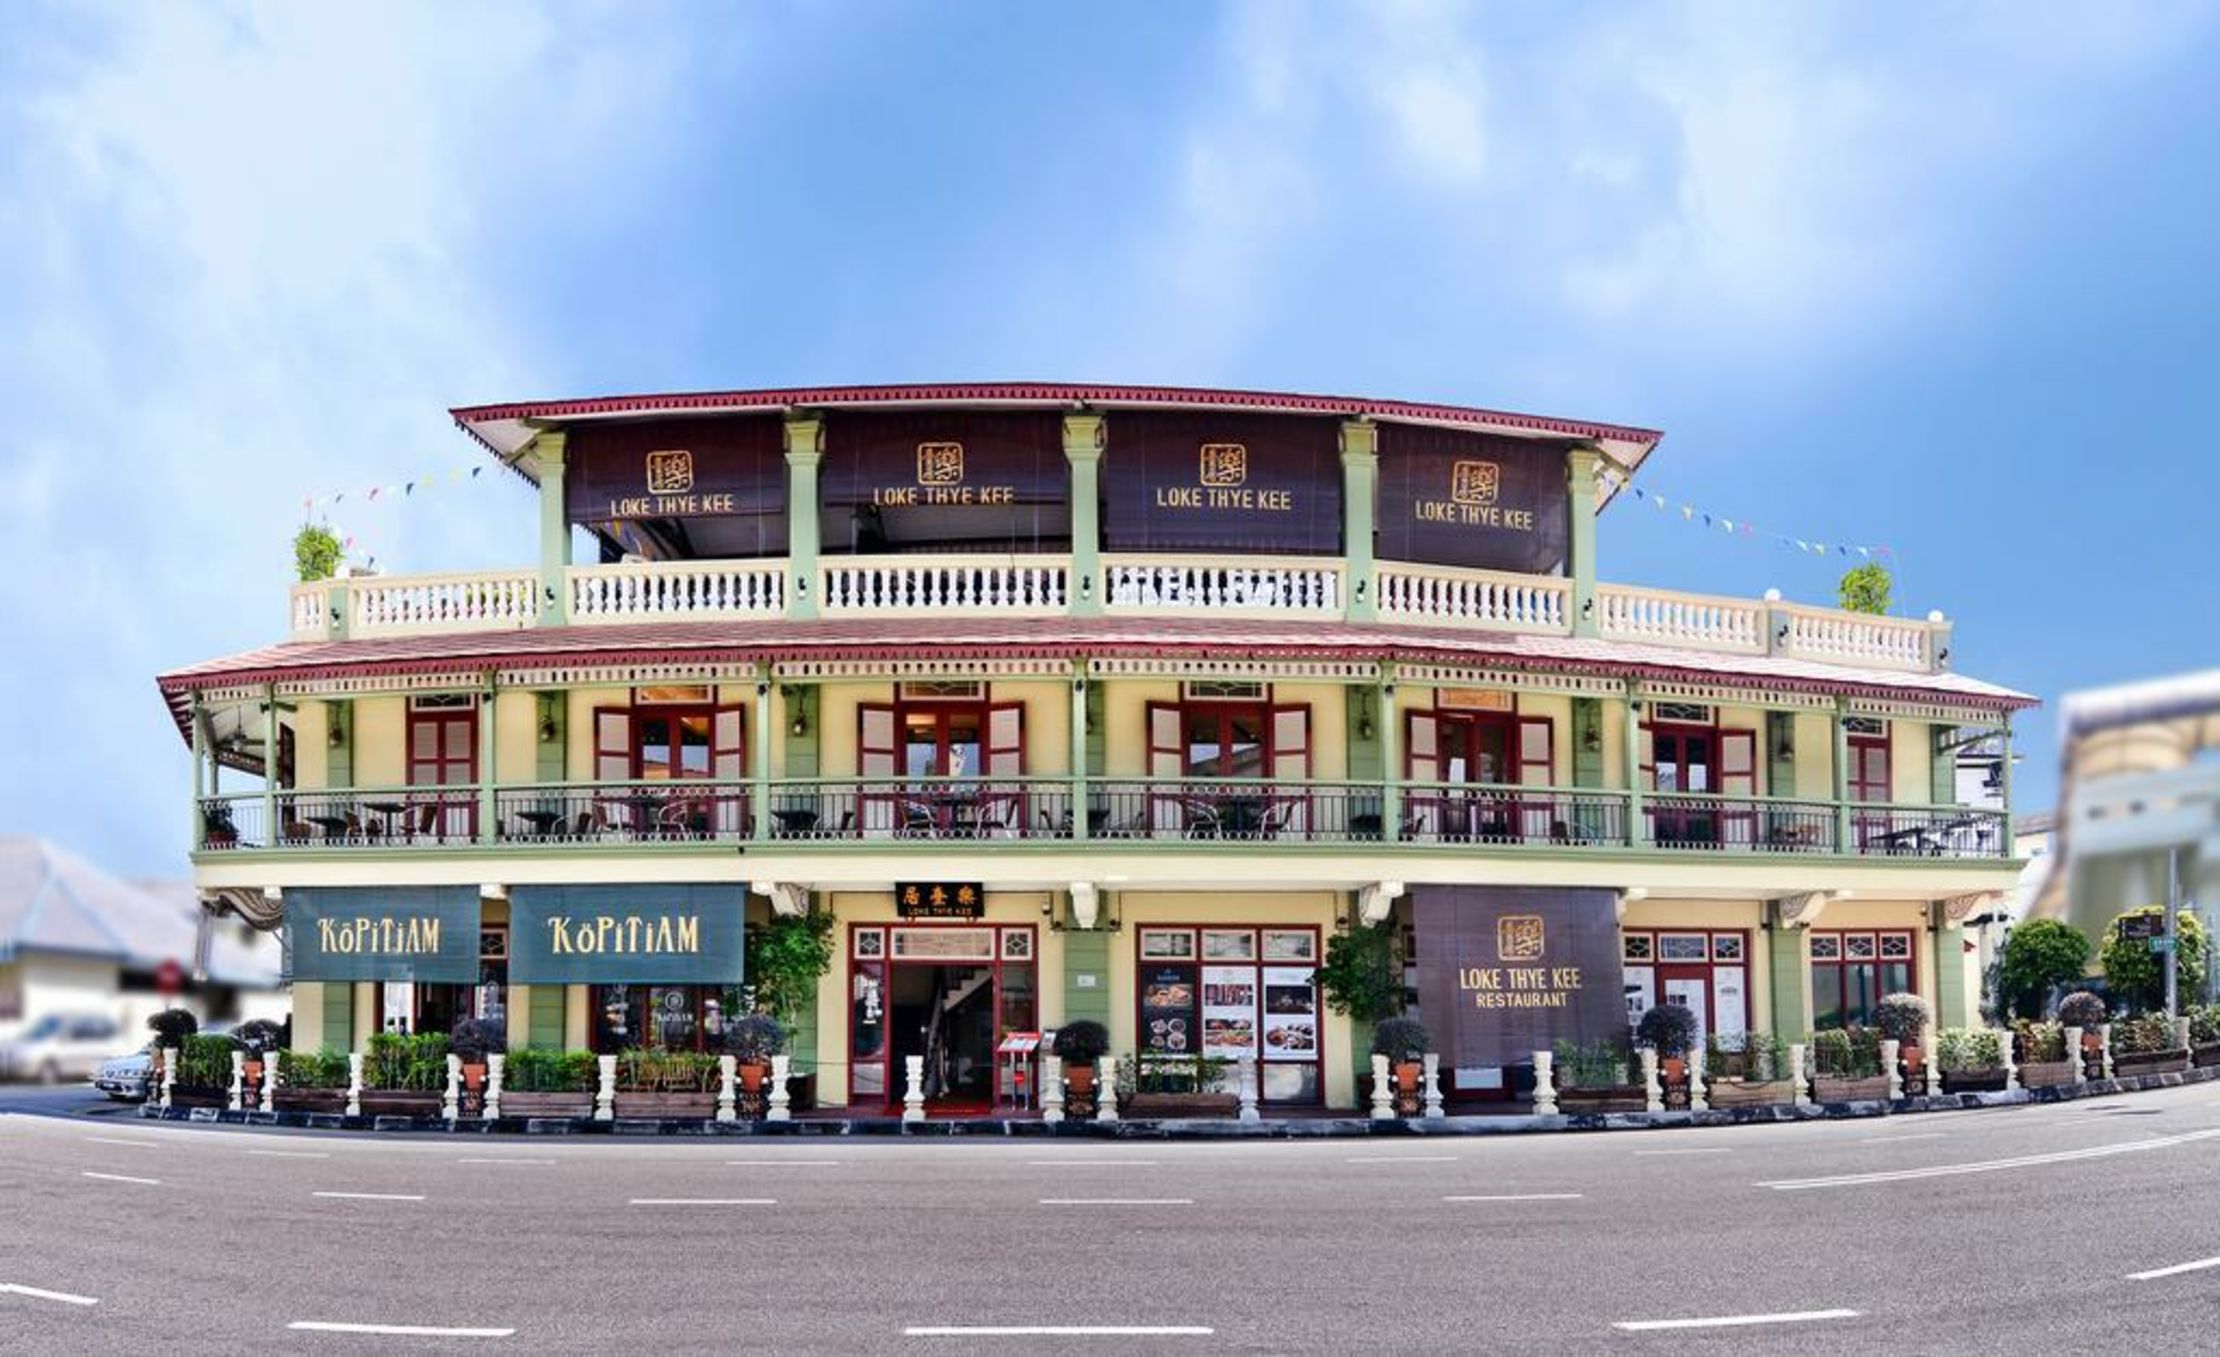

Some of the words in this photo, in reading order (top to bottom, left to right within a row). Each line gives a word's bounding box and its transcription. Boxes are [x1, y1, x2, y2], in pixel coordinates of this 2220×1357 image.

[610, 498, 650, 517] LOKE
[656, 495, 697, 513] THYE
[702, 493, 734, 512] KEE
[874, 487, 917, 506] LOKE
[925, 486, 972, 504] THYE
[1157, 487, 1202, 507] LOKE
[1207, 489, 1253, 508] THYE
[1258, 490, 1292, 510] KEE
[1415, 500, 1456, 522] LOKE
[1461, 504, 1500, 527] THYE
[1504, 508, 1533, 531] KEE
[1460, 968, 1502, 990] LOKE
[1507, 968, 1547, 990] THYE
[1552, 967, 1581, 989] KEE
[1476, 992, 1567, 1008] RESTAURANT
